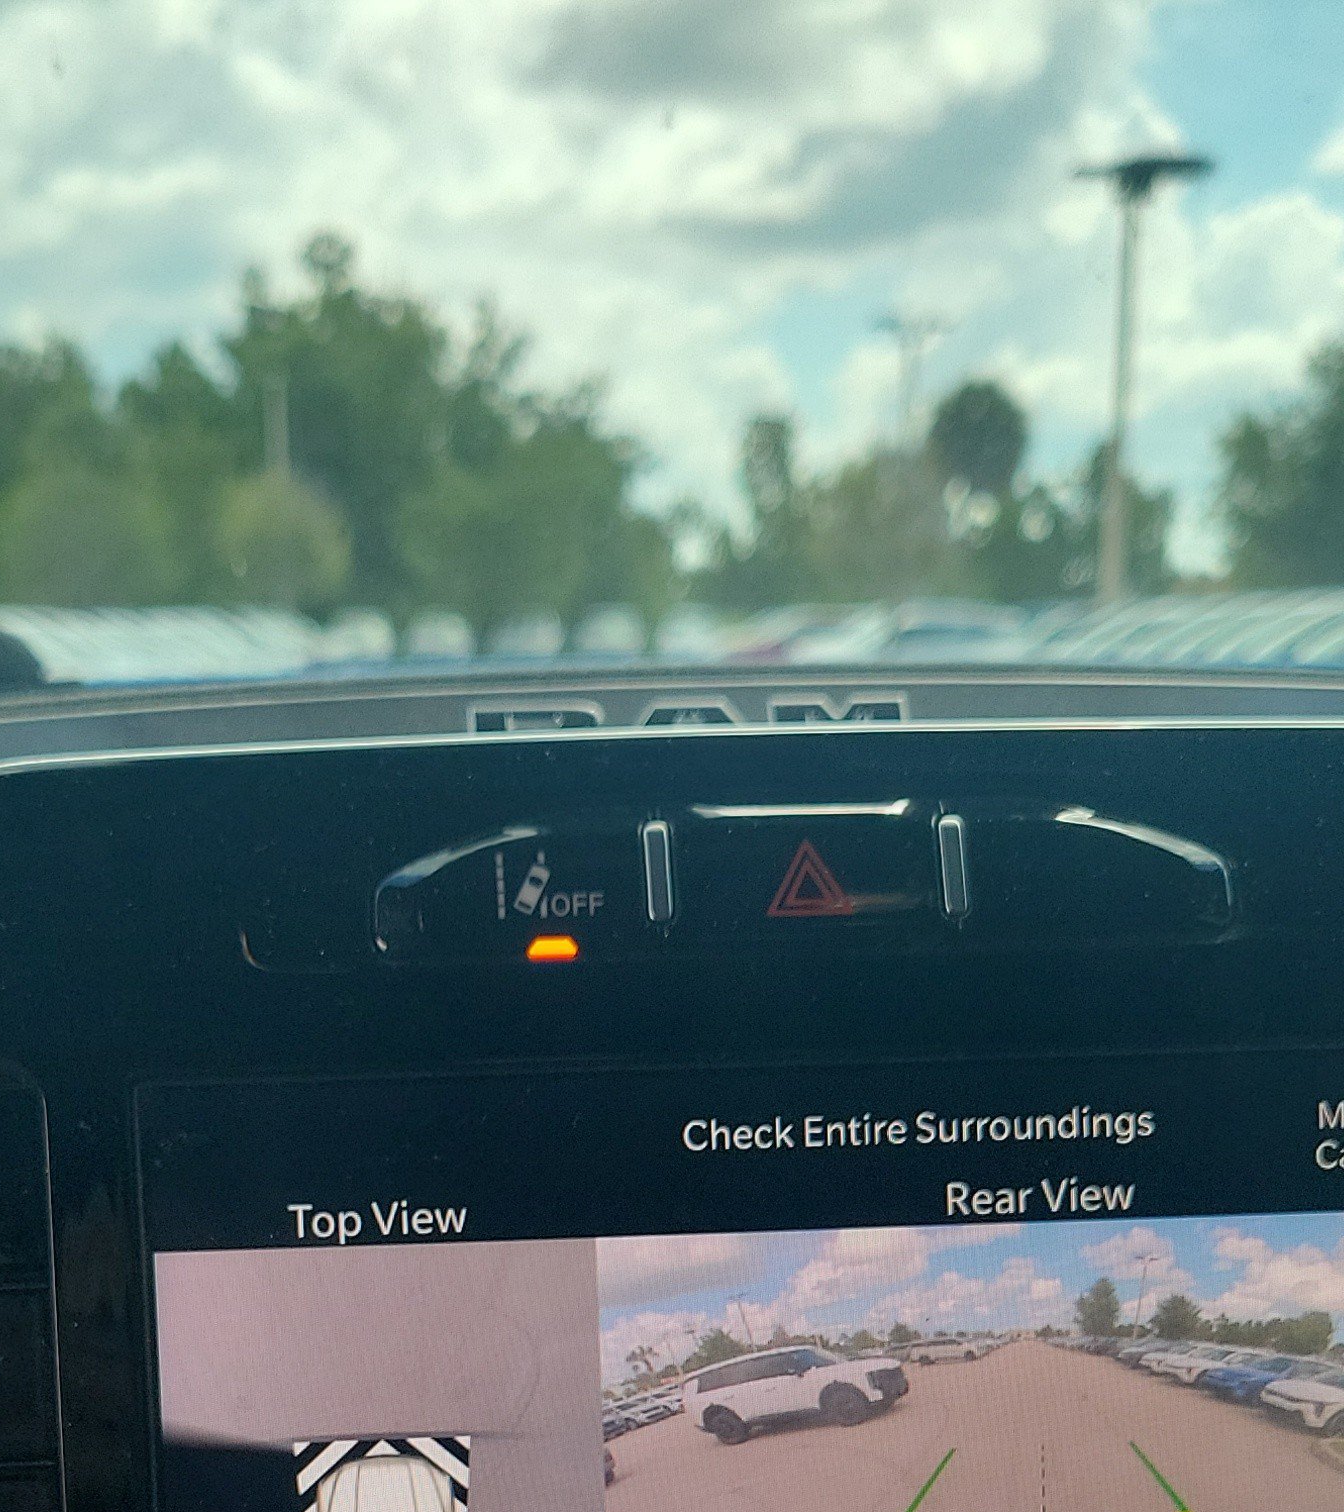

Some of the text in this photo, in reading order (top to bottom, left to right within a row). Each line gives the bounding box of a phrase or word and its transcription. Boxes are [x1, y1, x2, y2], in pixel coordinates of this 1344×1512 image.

[551, 891, 604, 918] OFF
[682, 1105, 1156, 1152] Check Entire Surroundings
[946, 1176, 1136, 1217] Rear View
[287, 1200, 467, 1244] Top View
